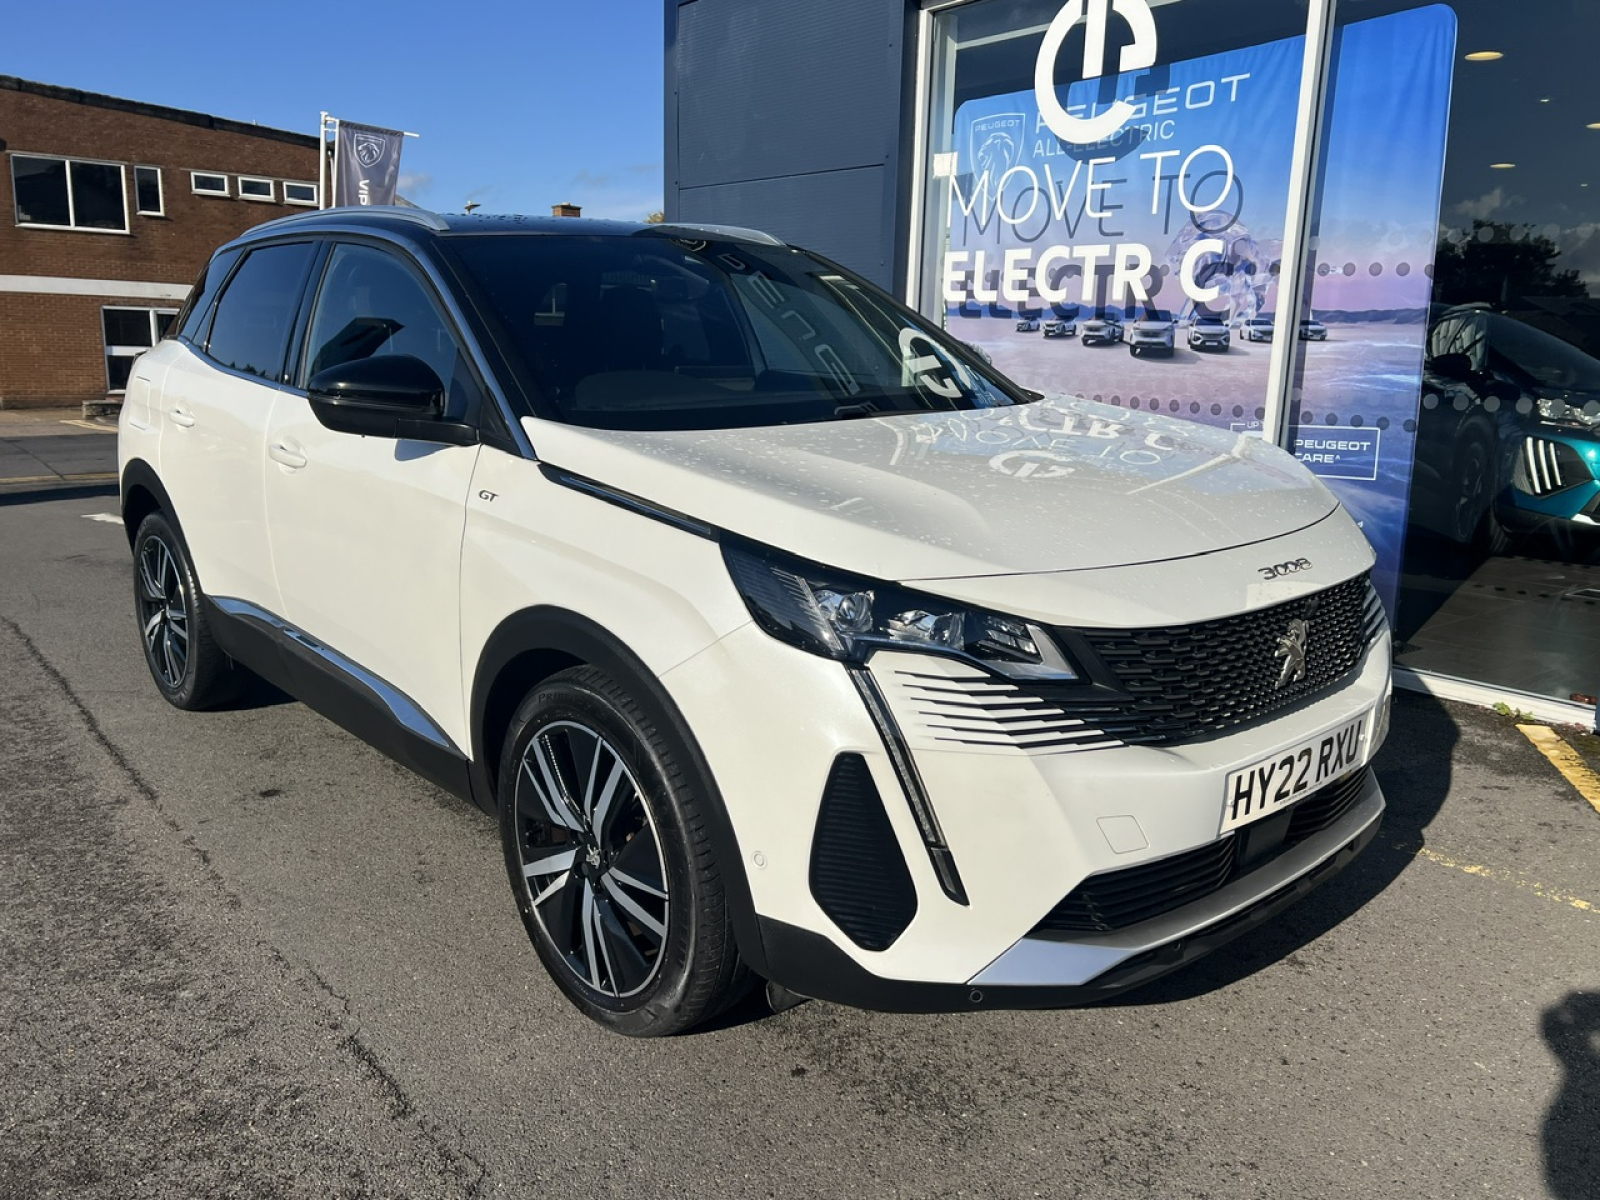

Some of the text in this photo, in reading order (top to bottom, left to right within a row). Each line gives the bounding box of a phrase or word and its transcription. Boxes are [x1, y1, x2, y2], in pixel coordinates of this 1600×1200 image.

[974, 119, 1020, 132] PEUGEOT
[947, 144, 1234, 228] MOVE TO
[1294, 439, 1371, 452] PEUGEOT
[478, 489, 499, 502] GT
[1257, 557, 1313, 580] 3008
[1231, 719, 1362, 821] HY22 RXU
